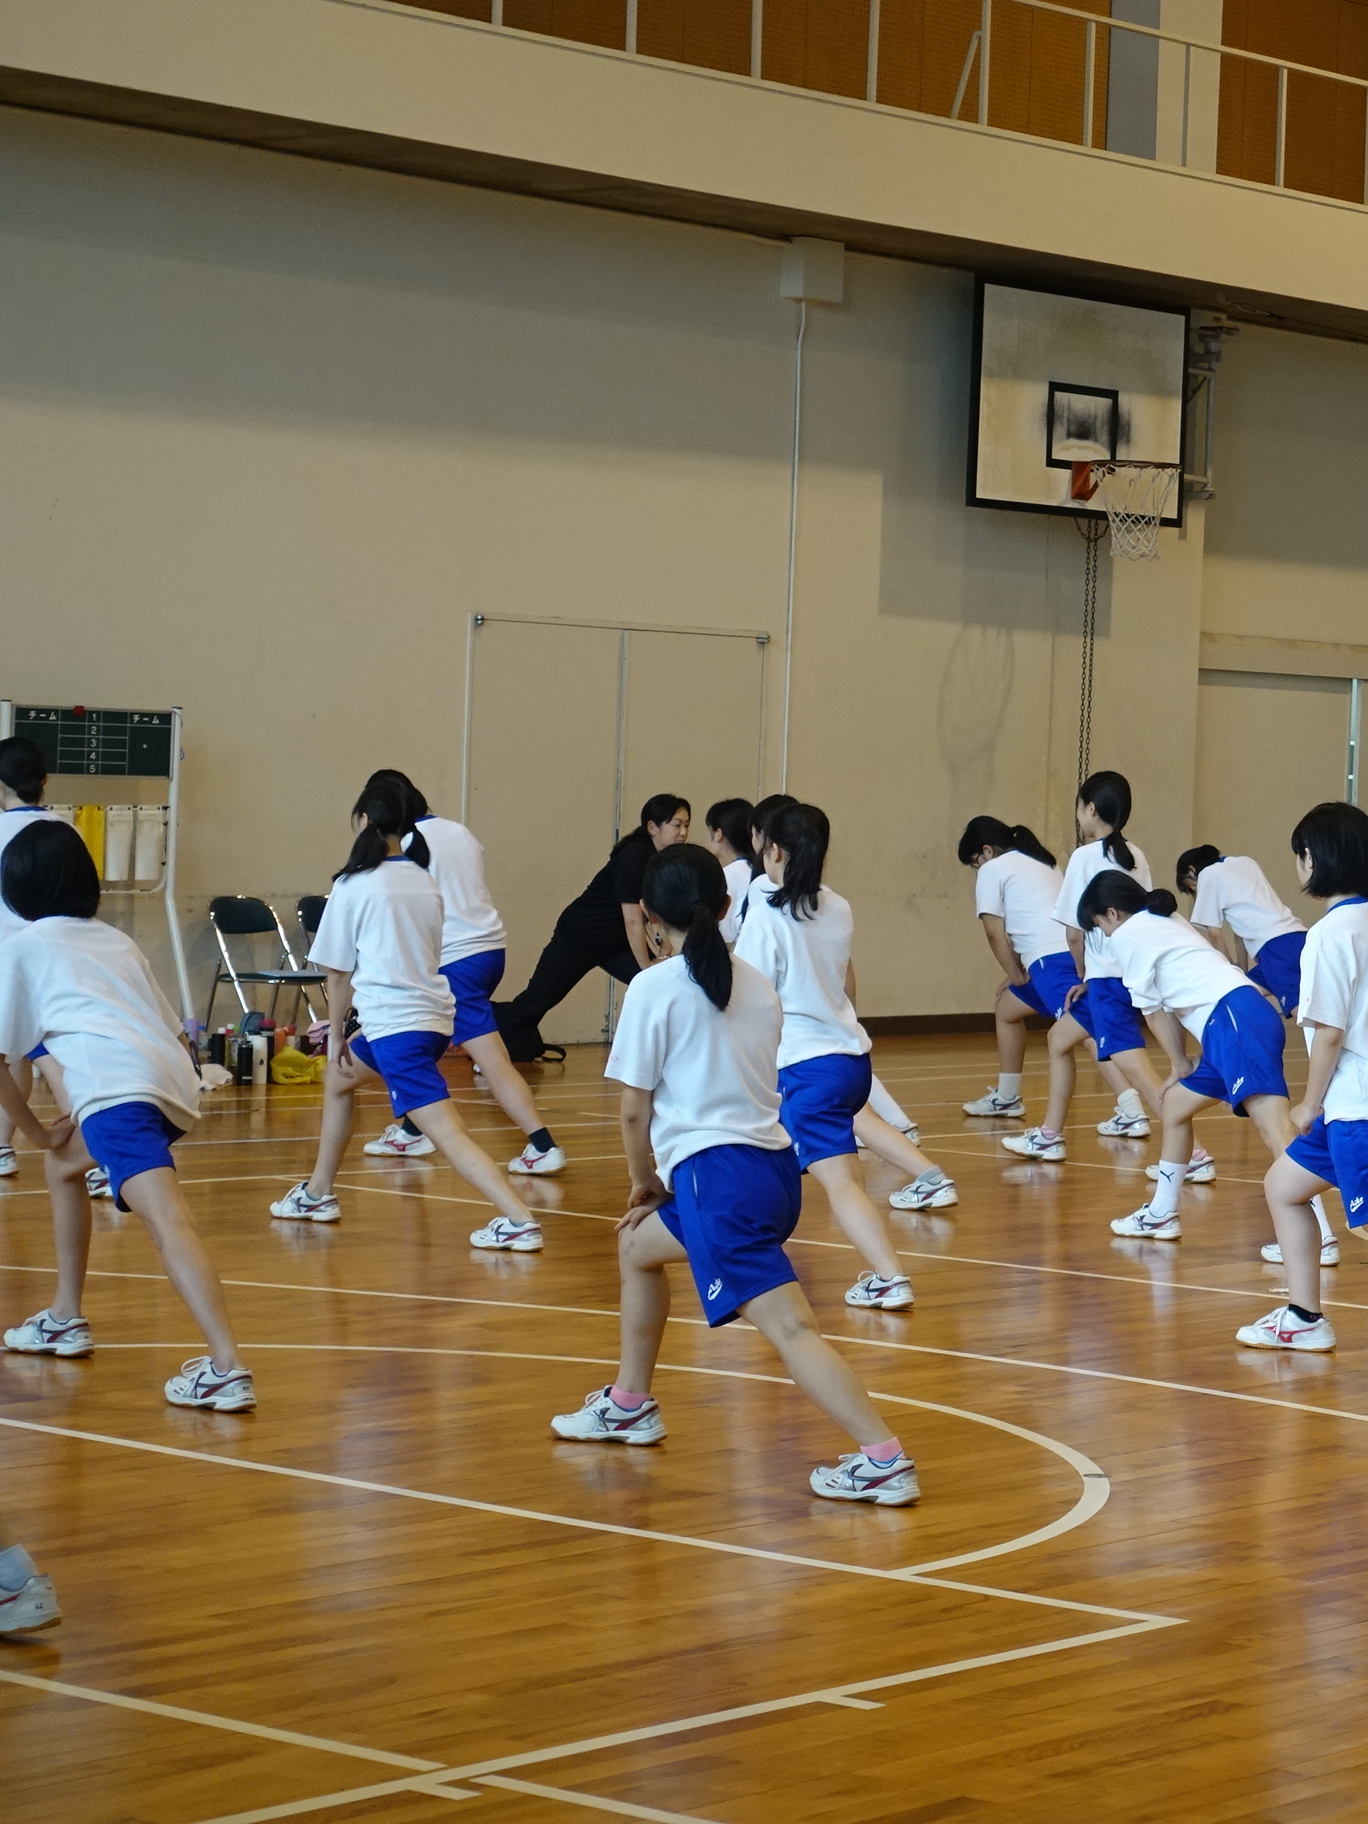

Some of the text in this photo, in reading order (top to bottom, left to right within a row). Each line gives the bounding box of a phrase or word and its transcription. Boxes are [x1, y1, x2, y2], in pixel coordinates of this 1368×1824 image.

[28, 711, 57, 720] チーム
[92, 713, 97, 721] 1
[132, 715, 160, 724] チーム
[91, 726, 97, 735] 2
[90, 739, 96, 748] 3
[90, 752, 96, 760] 4
[90, 765, 96, 773] 5
